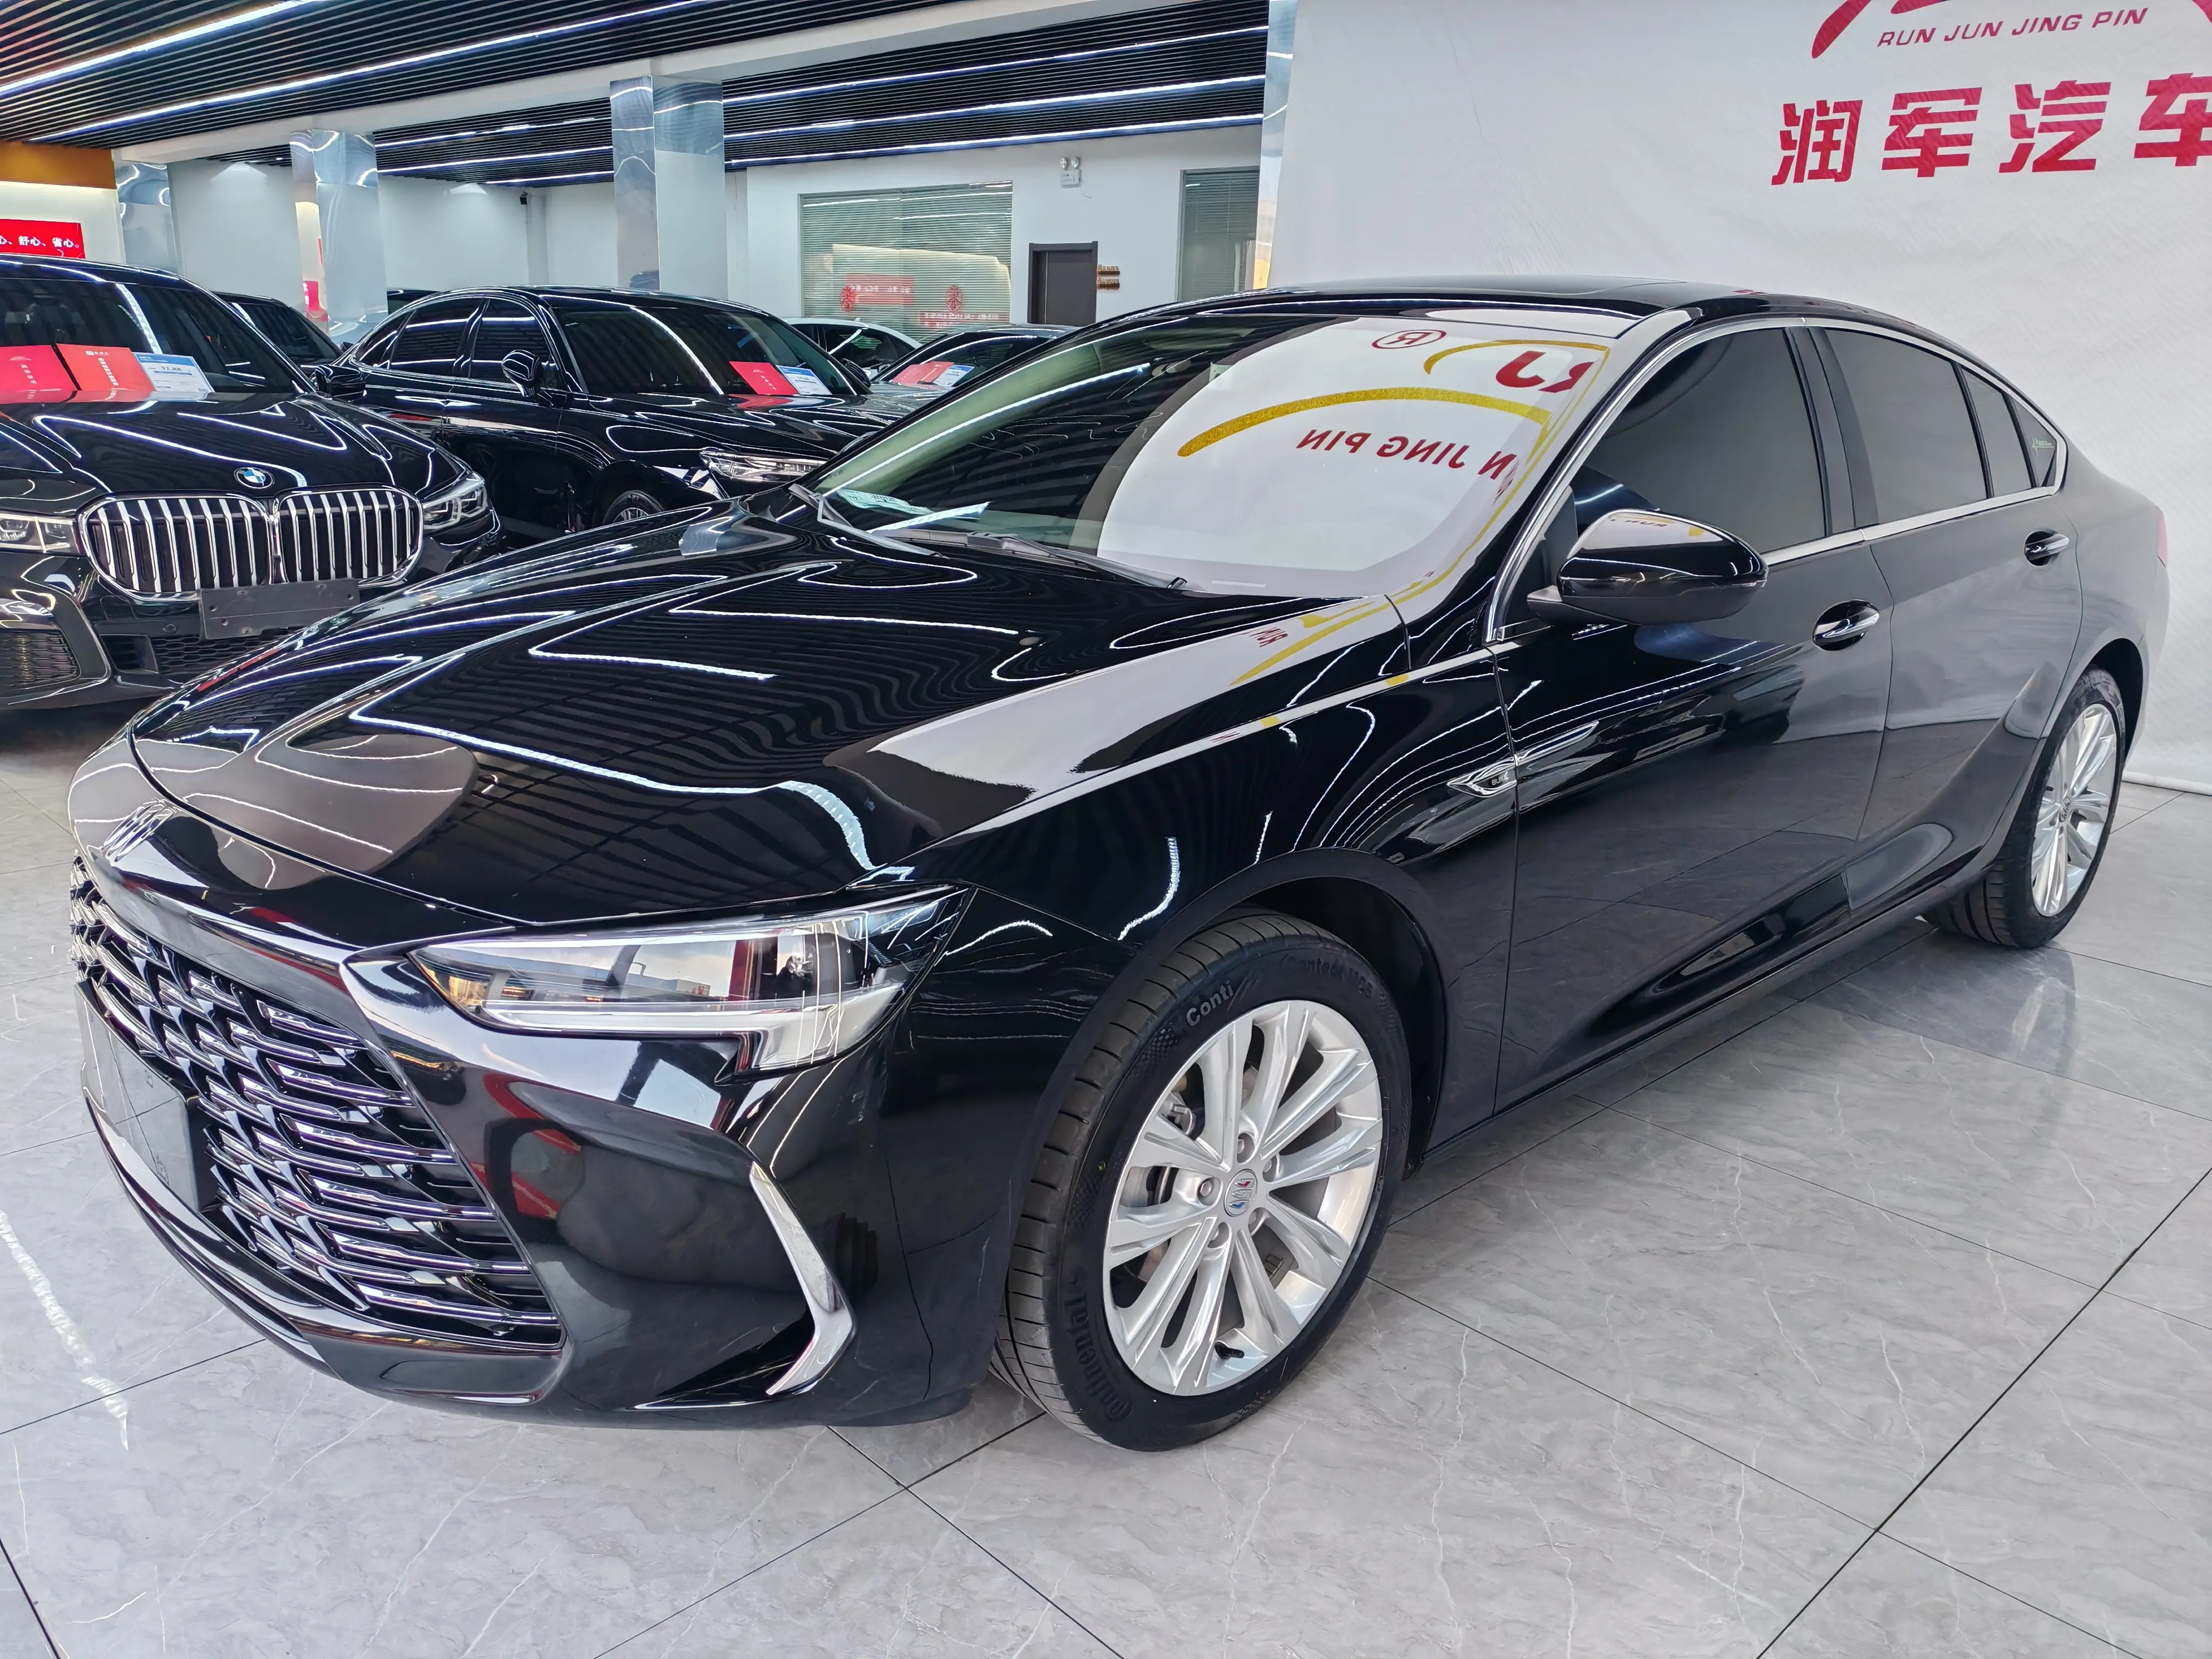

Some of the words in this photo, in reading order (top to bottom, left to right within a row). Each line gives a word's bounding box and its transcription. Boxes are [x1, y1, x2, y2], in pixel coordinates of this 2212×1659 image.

[1877, 27, 1936, 48] RUN
[1943, 21, 2004, 42] JUN
[2011, 14, 2083, 36] JING
[2091, 8, 2148, 29] PIN
[1771, 72, 2212, 186] 润军汽车
[1185, 980, 1234, 1027] Conti
